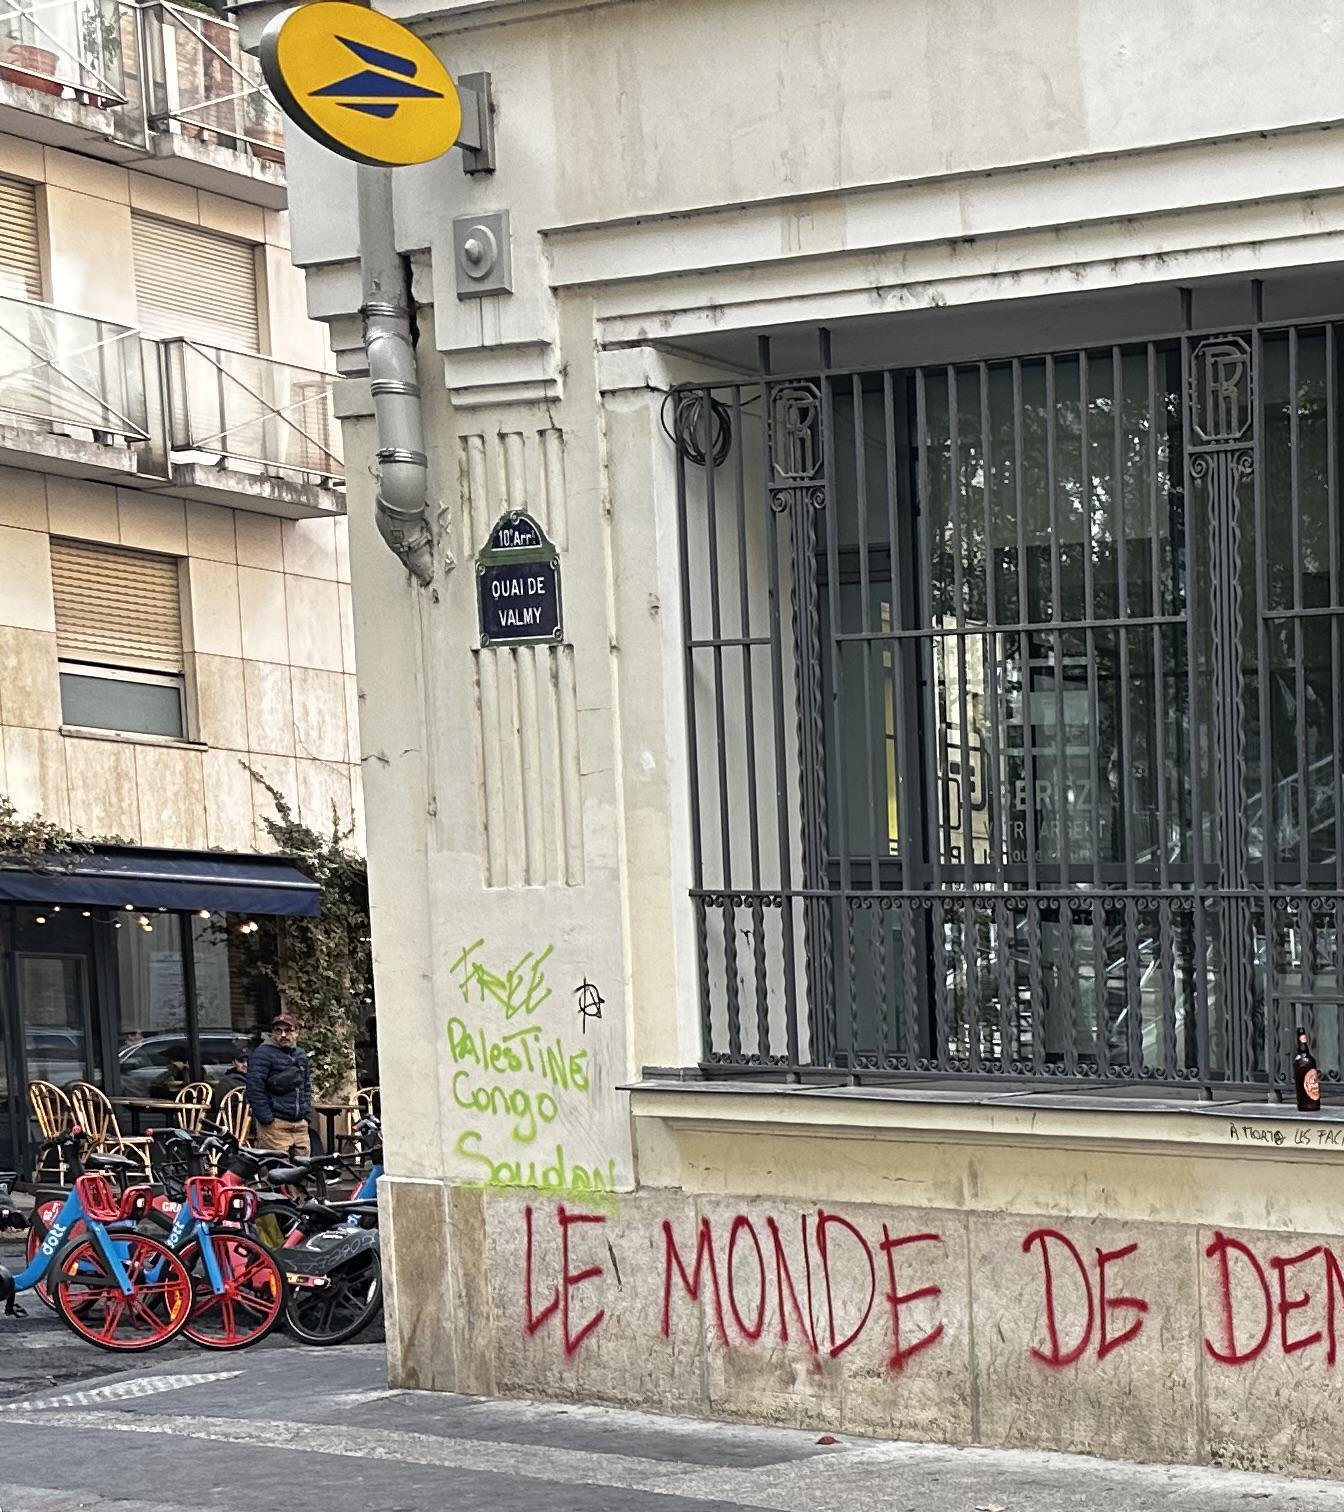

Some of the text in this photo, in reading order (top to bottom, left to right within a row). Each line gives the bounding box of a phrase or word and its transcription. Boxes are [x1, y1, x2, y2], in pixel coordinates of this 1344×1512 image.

[491, 576, 546, 601] QUAI DE
[498, 606, 542, 627] VALMY
[42, 1222, 68, 1256] dott
[523, 1203, 608, 1360] LE
[660, 1208, 945, 1375] MONDE
[1022, 1228, 1150, 1369] DE
